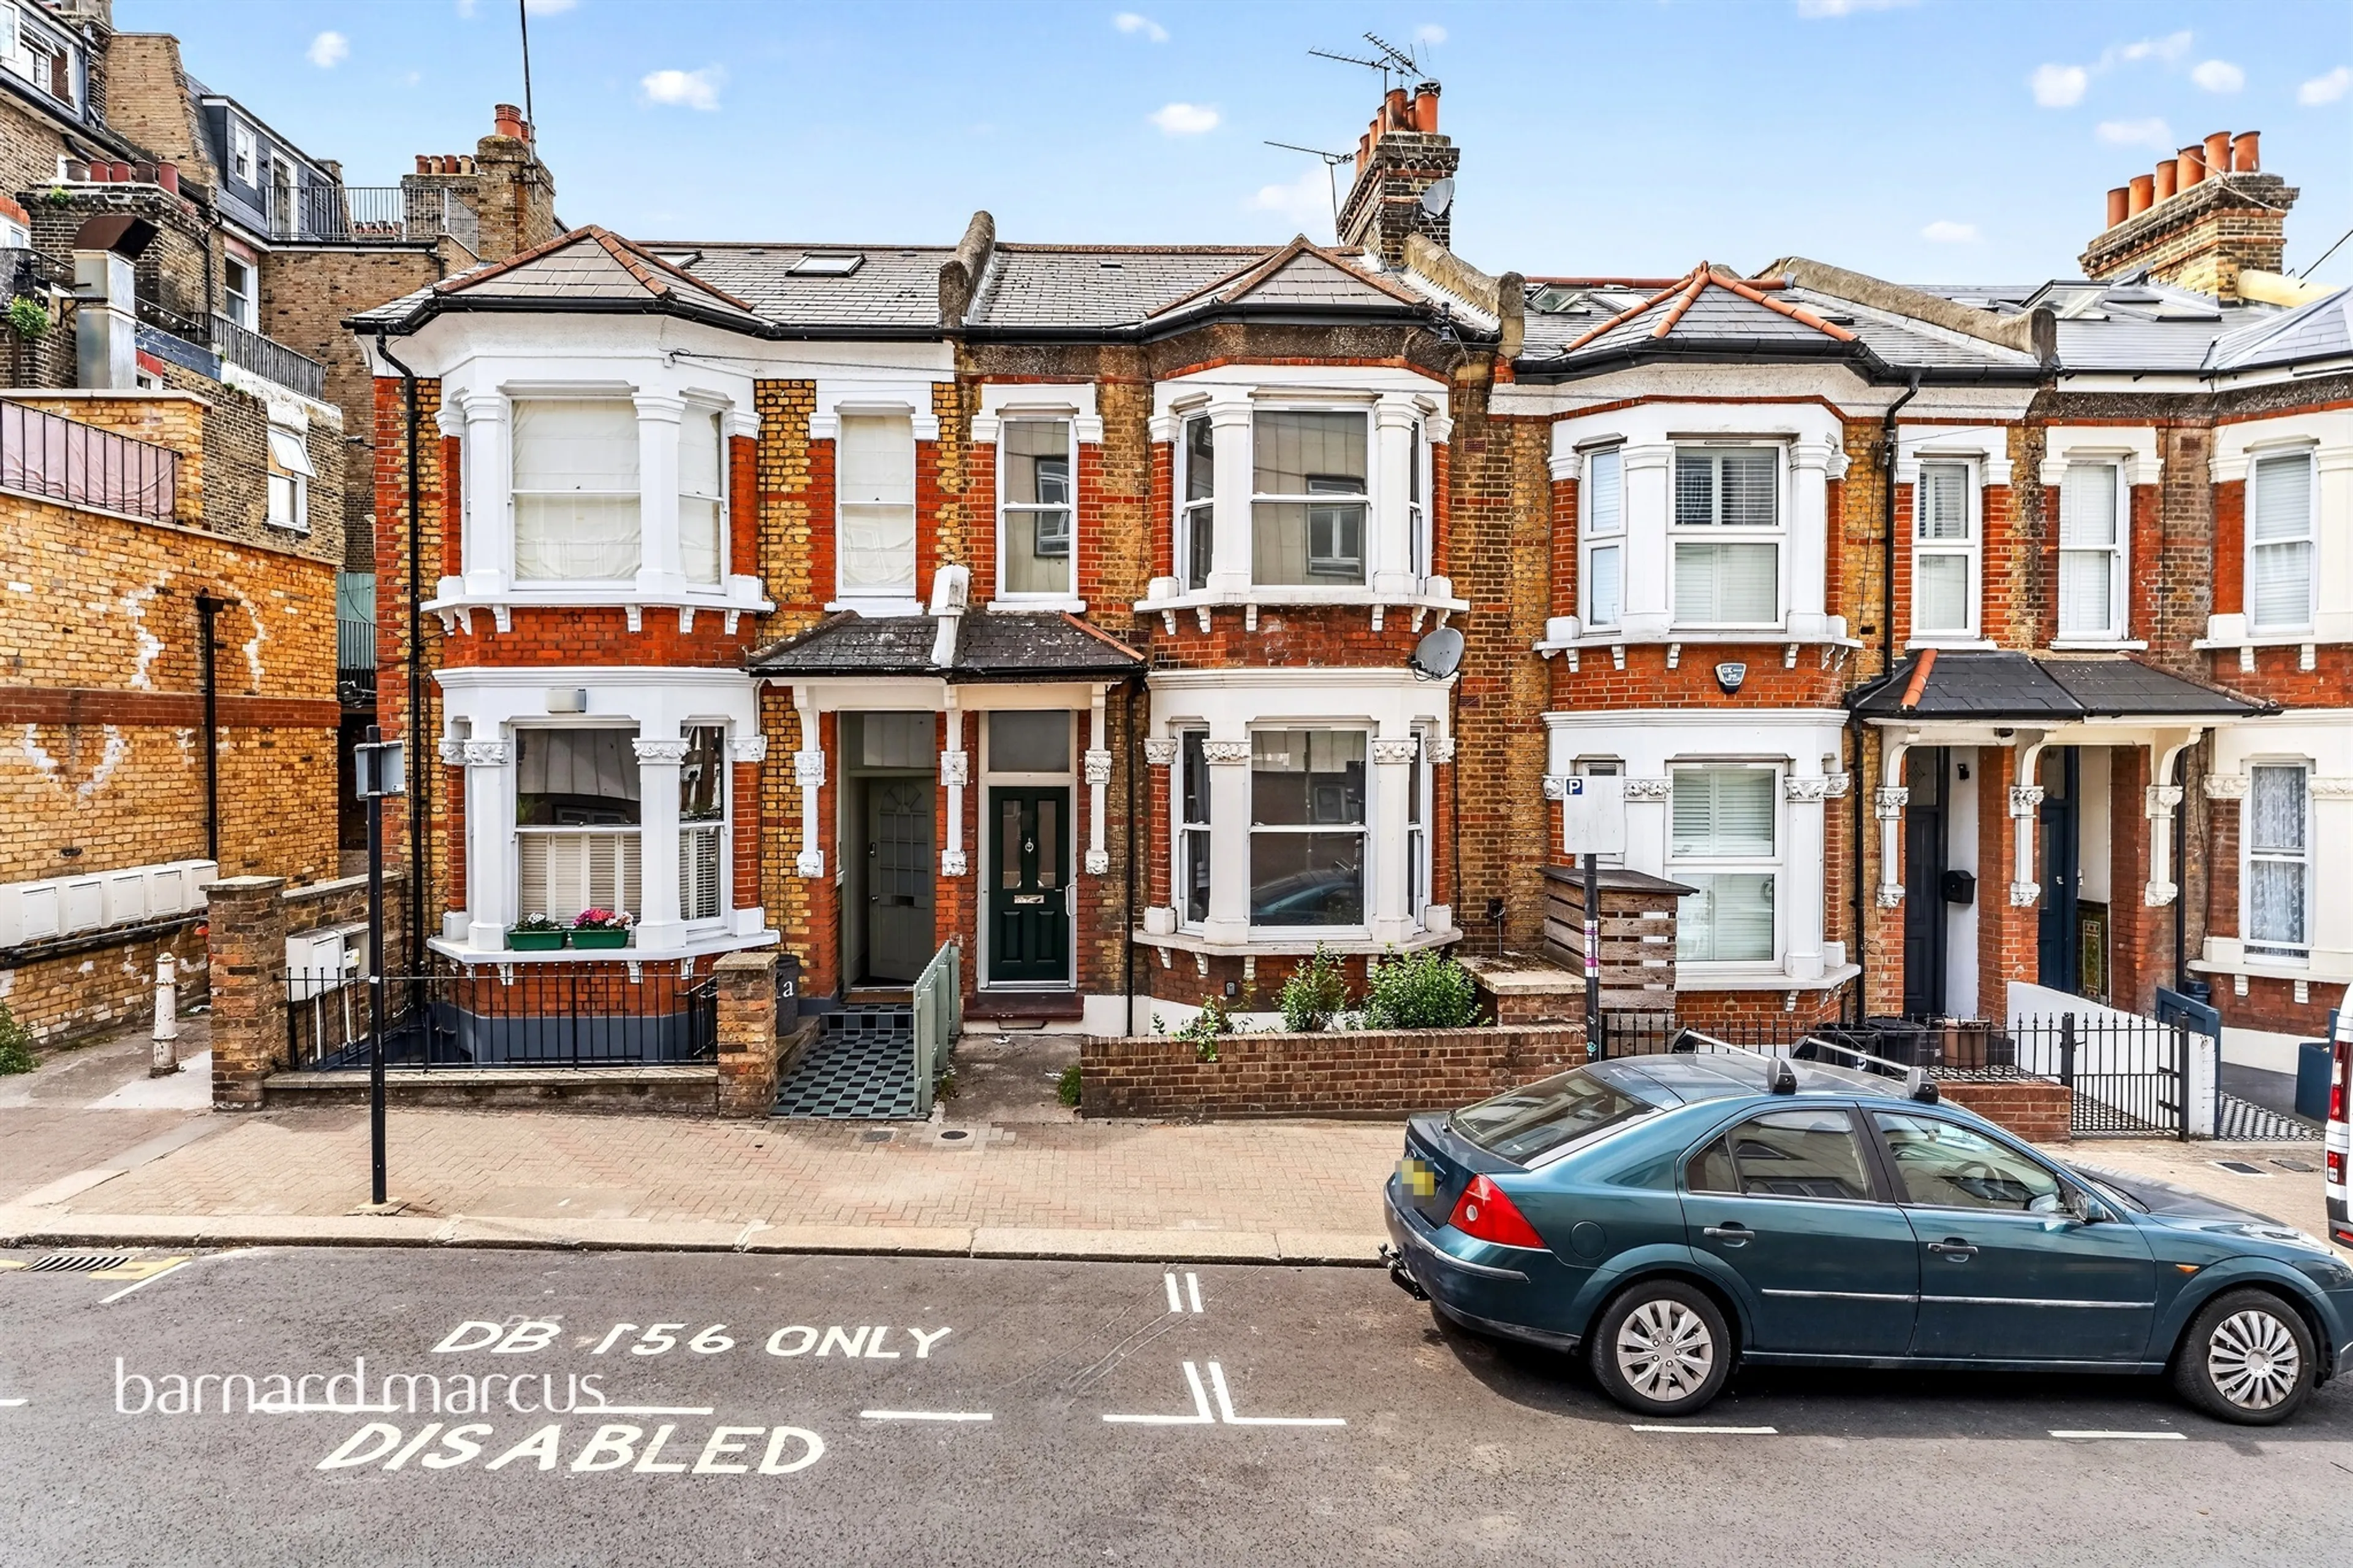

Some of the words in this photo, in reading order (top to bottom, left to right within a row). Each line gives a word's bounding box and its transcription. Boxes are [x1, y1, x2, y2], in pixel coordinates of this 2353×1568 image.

[1569, 780, 1581, 794] P
[431, 1321, 562, 1354] DB
[590, 1323, 735, 1355] 156
[765, 1325, 953, 1358] ONLY
[316, 1422, 825, 1475] DISABLED
